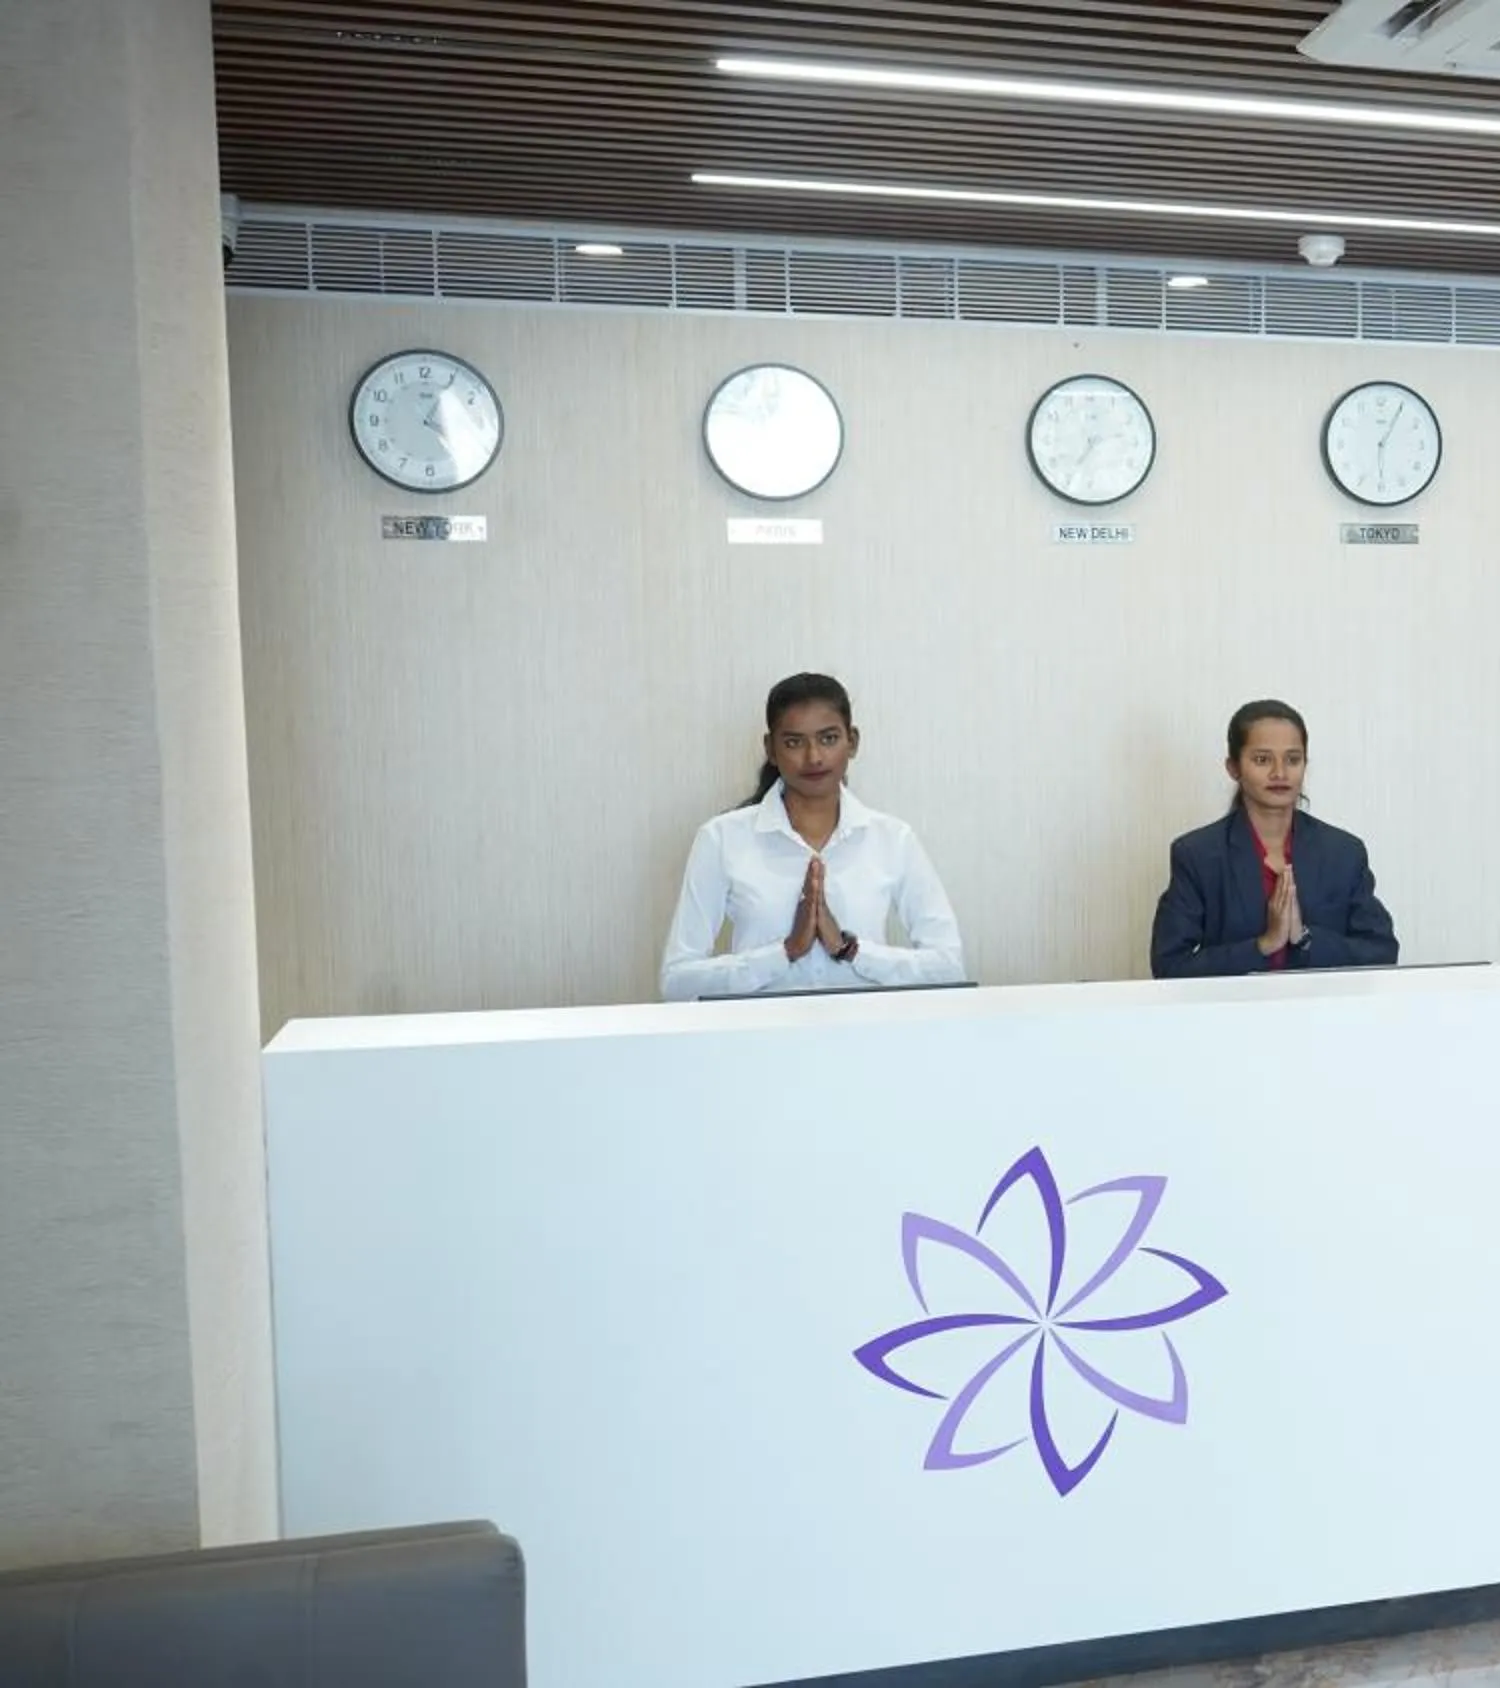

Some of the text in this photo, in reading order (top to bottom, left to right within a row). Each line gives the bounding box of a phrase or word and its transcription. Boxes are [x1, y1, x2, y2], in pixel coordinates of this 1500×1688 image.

[419, 366, 433, 379] 12
[374, 388, 387, 402] 10
[393, 521, 429, 535] NEW
[1059, 527, 1129, 539] NEW DELHI
[1360, 527, 1400, 541] TOKYO
